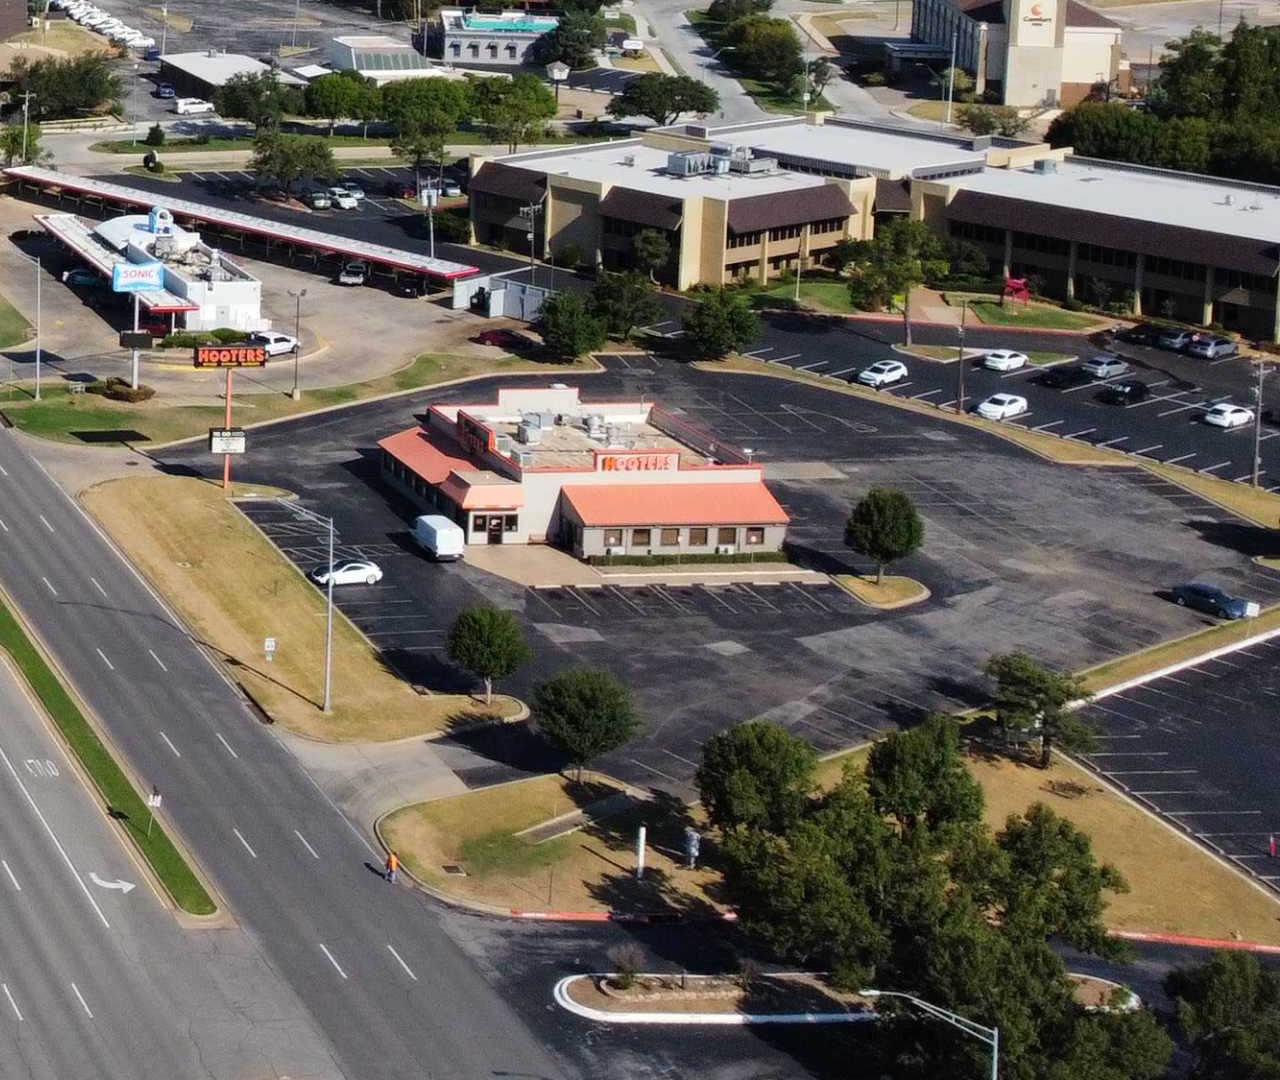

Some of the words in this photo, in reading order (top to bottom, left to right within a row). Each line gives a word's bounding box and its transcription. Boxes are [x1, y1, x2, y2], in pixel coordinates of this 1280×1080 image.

[123, 269, 154, 279] SONIC
[198, 348, 264, 362] HOOTERS
[602, 456, 673, 471] HOOTERS
